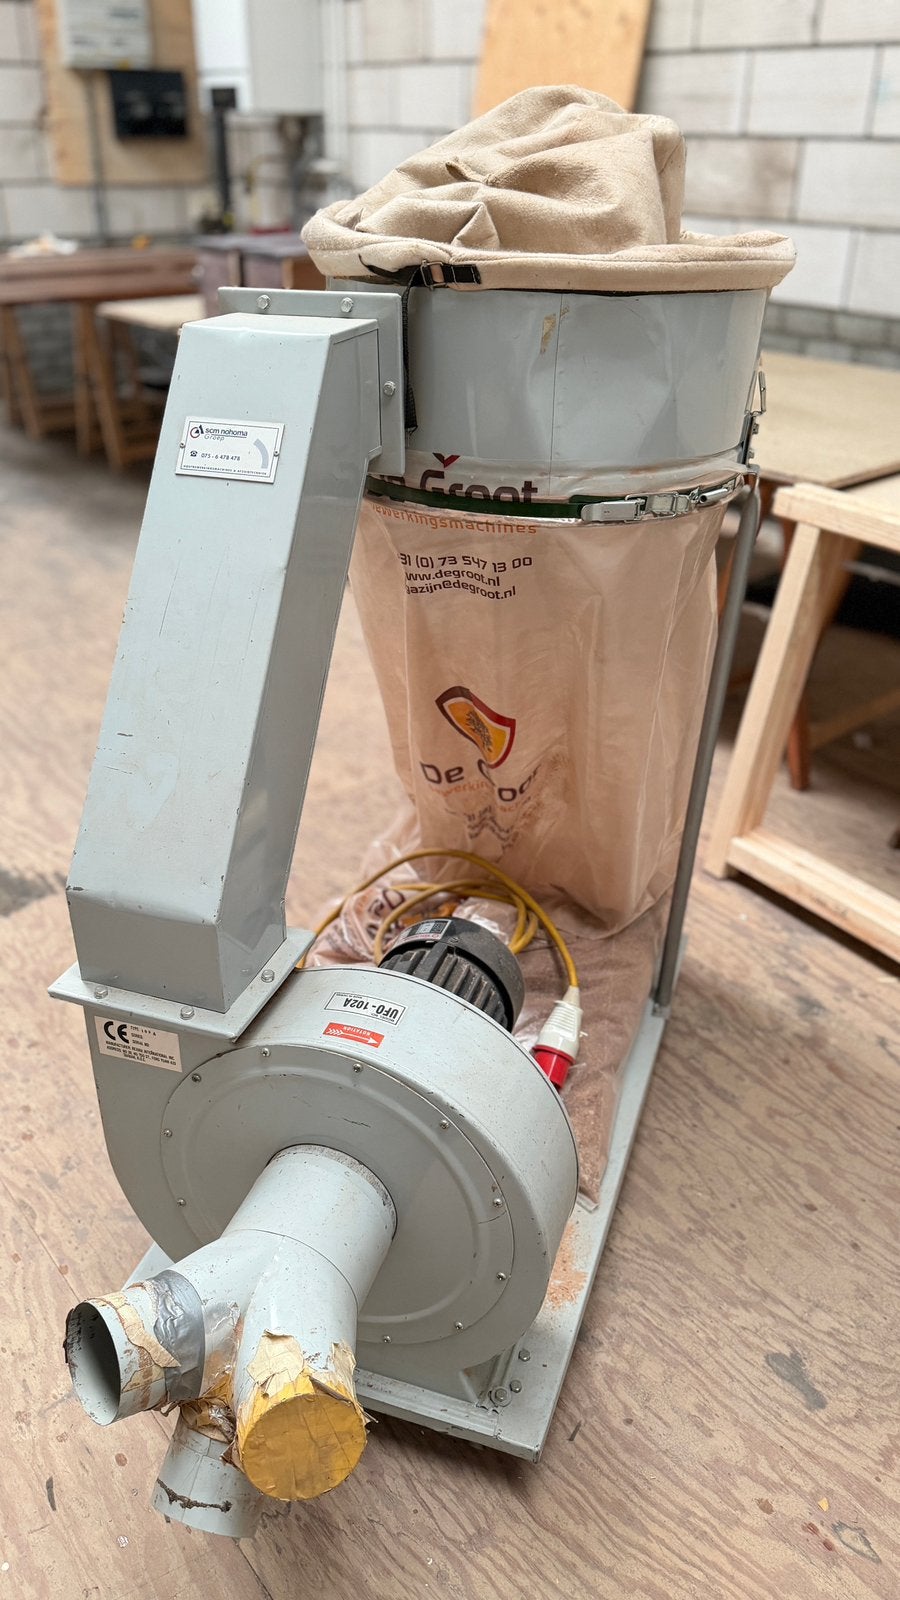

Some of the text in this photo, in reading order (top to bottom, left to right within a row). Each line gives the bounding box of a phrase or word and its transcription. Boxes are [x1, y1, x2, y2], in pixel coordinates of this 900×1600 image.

[204, 433, 225, 442] Groep
[205, 427, 248, 437] scm nohoma
[372, 503, 537, 534] ewerkingsmachines
[399, 552, 533, 573] 31 (0) 73 547 13 00
[405, 569, 500, 587] ww.degroot.nl
[420, 761, 464, 784] De
[343, 1026, 371, 1036] ROTATION
